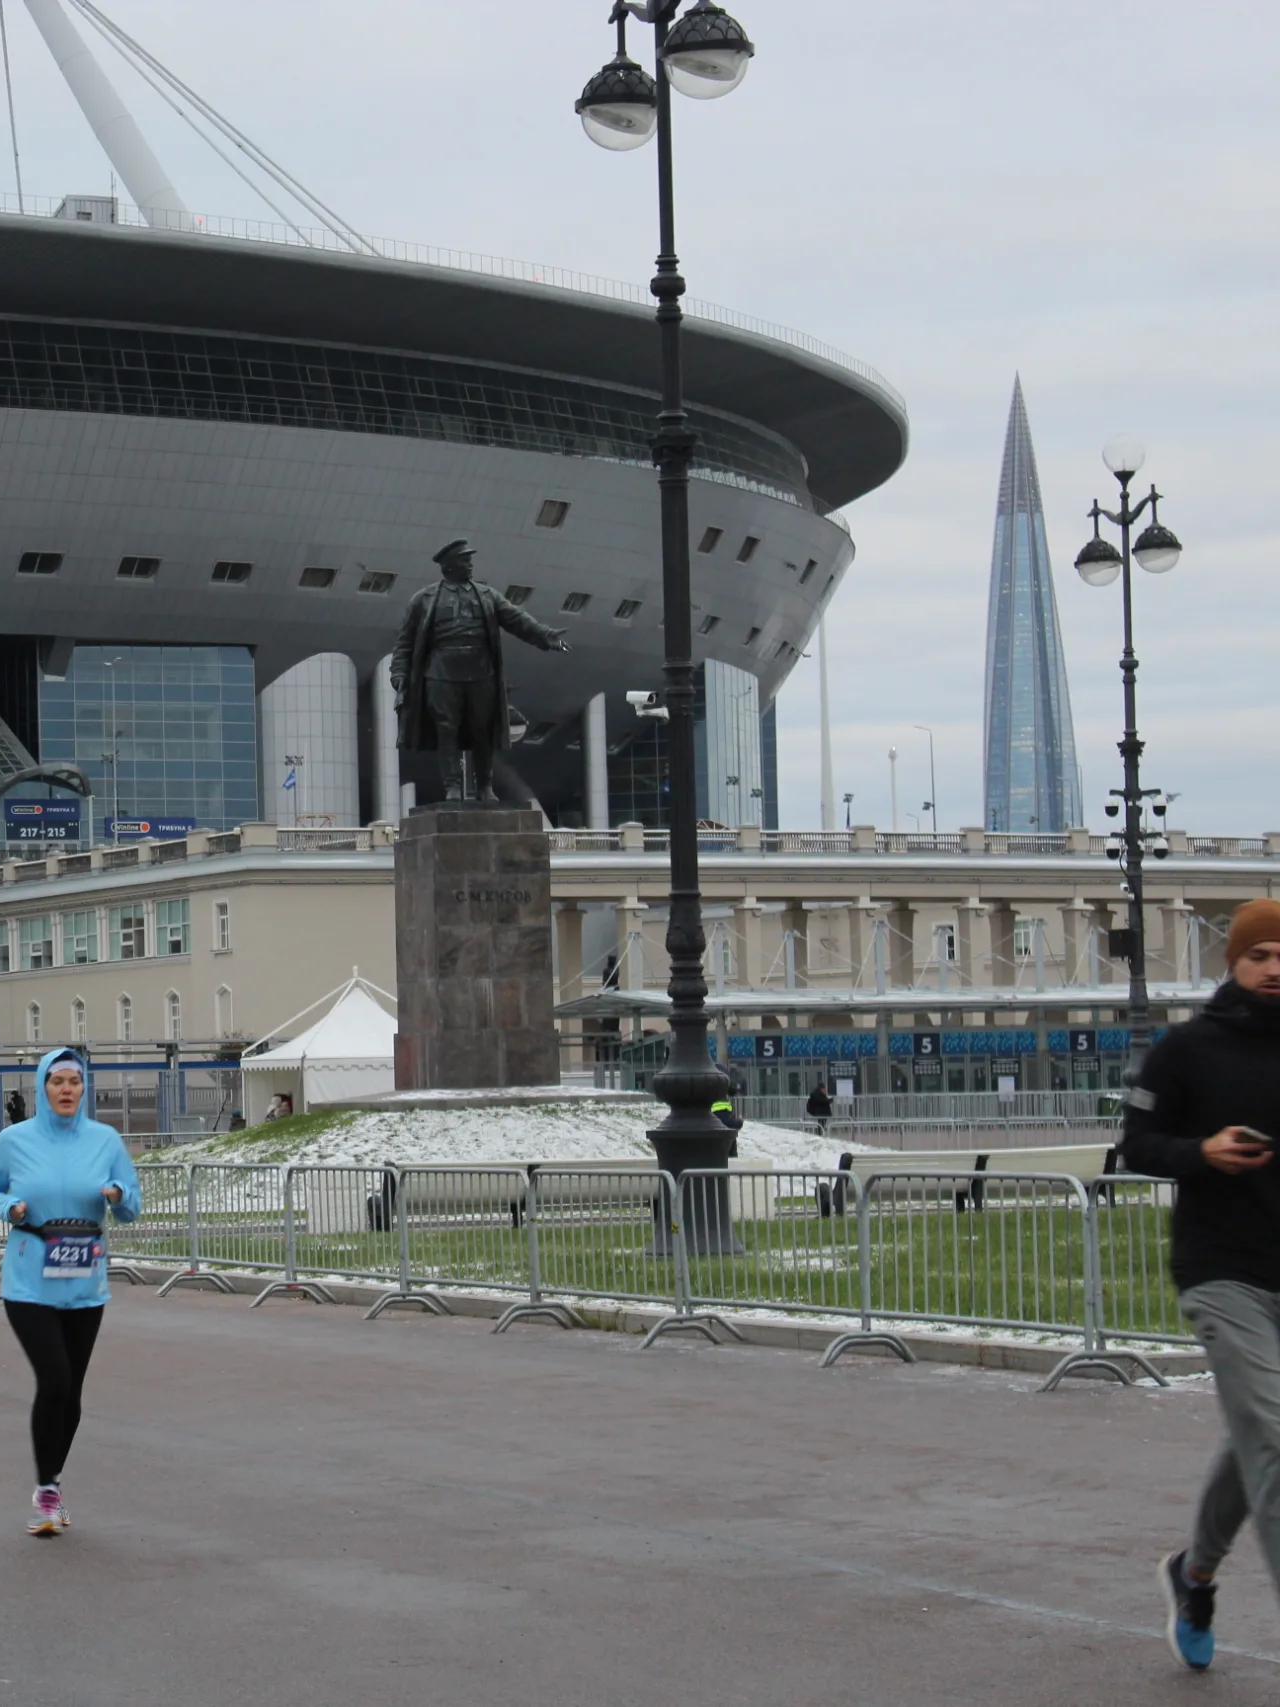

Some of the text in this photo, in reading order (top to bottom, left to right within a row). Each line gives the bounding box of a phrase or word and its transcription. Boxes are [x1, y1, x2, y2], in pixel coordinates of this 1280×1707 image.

[763, 1039, 774, 1057] 5
[921, 1037, 932, 1054] 5
[1077, 1034, 1088, 1051] 5
